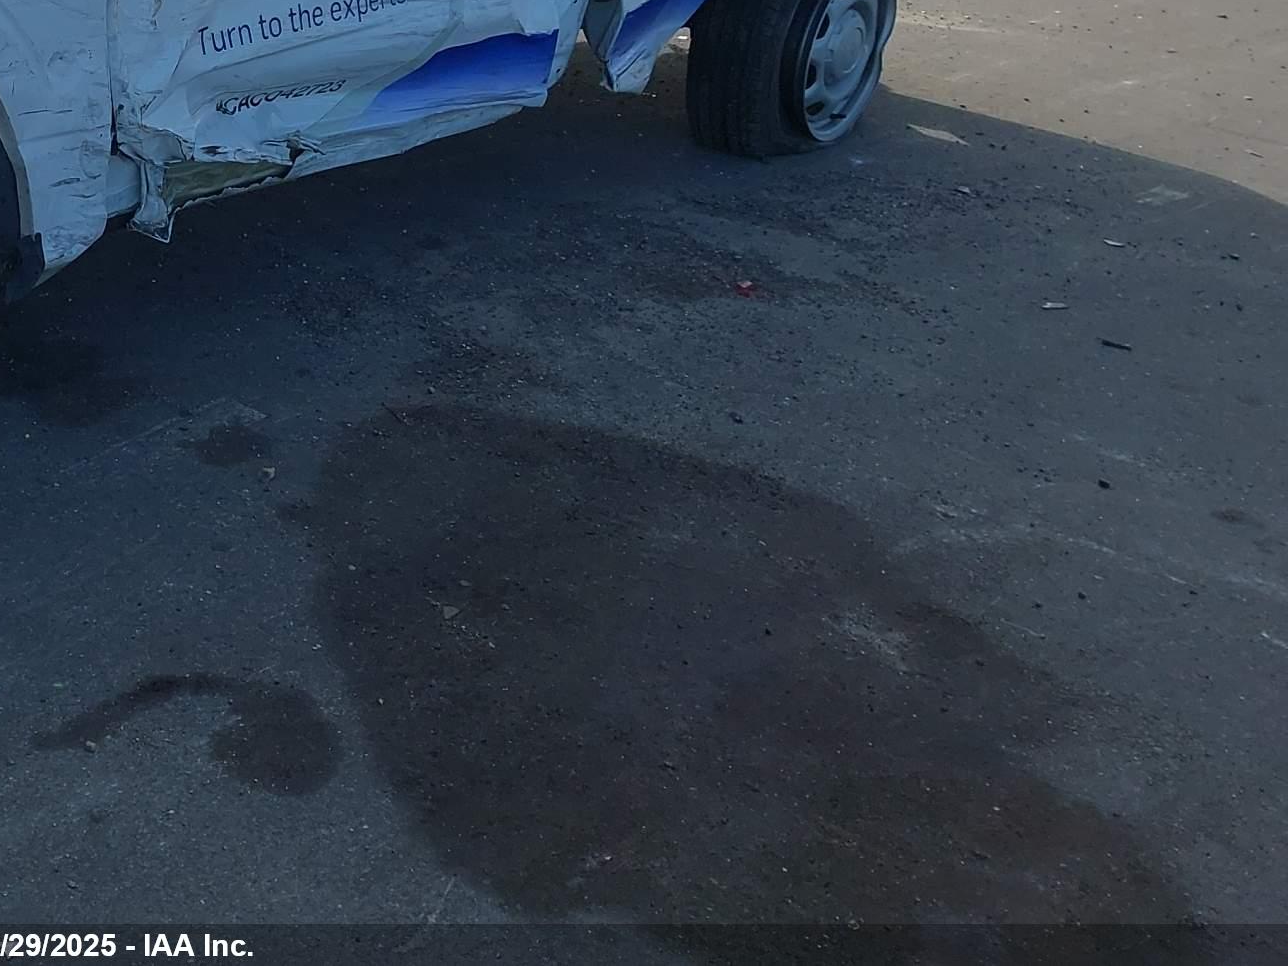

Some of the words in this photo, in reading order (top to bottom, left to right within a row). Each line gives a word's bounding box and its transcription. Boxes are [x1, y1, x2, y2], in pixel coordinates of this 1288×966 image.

[198, 23, 253, 56] Turn
[258, 14, 283, 40] to
[288, 3, 324, 33] the
